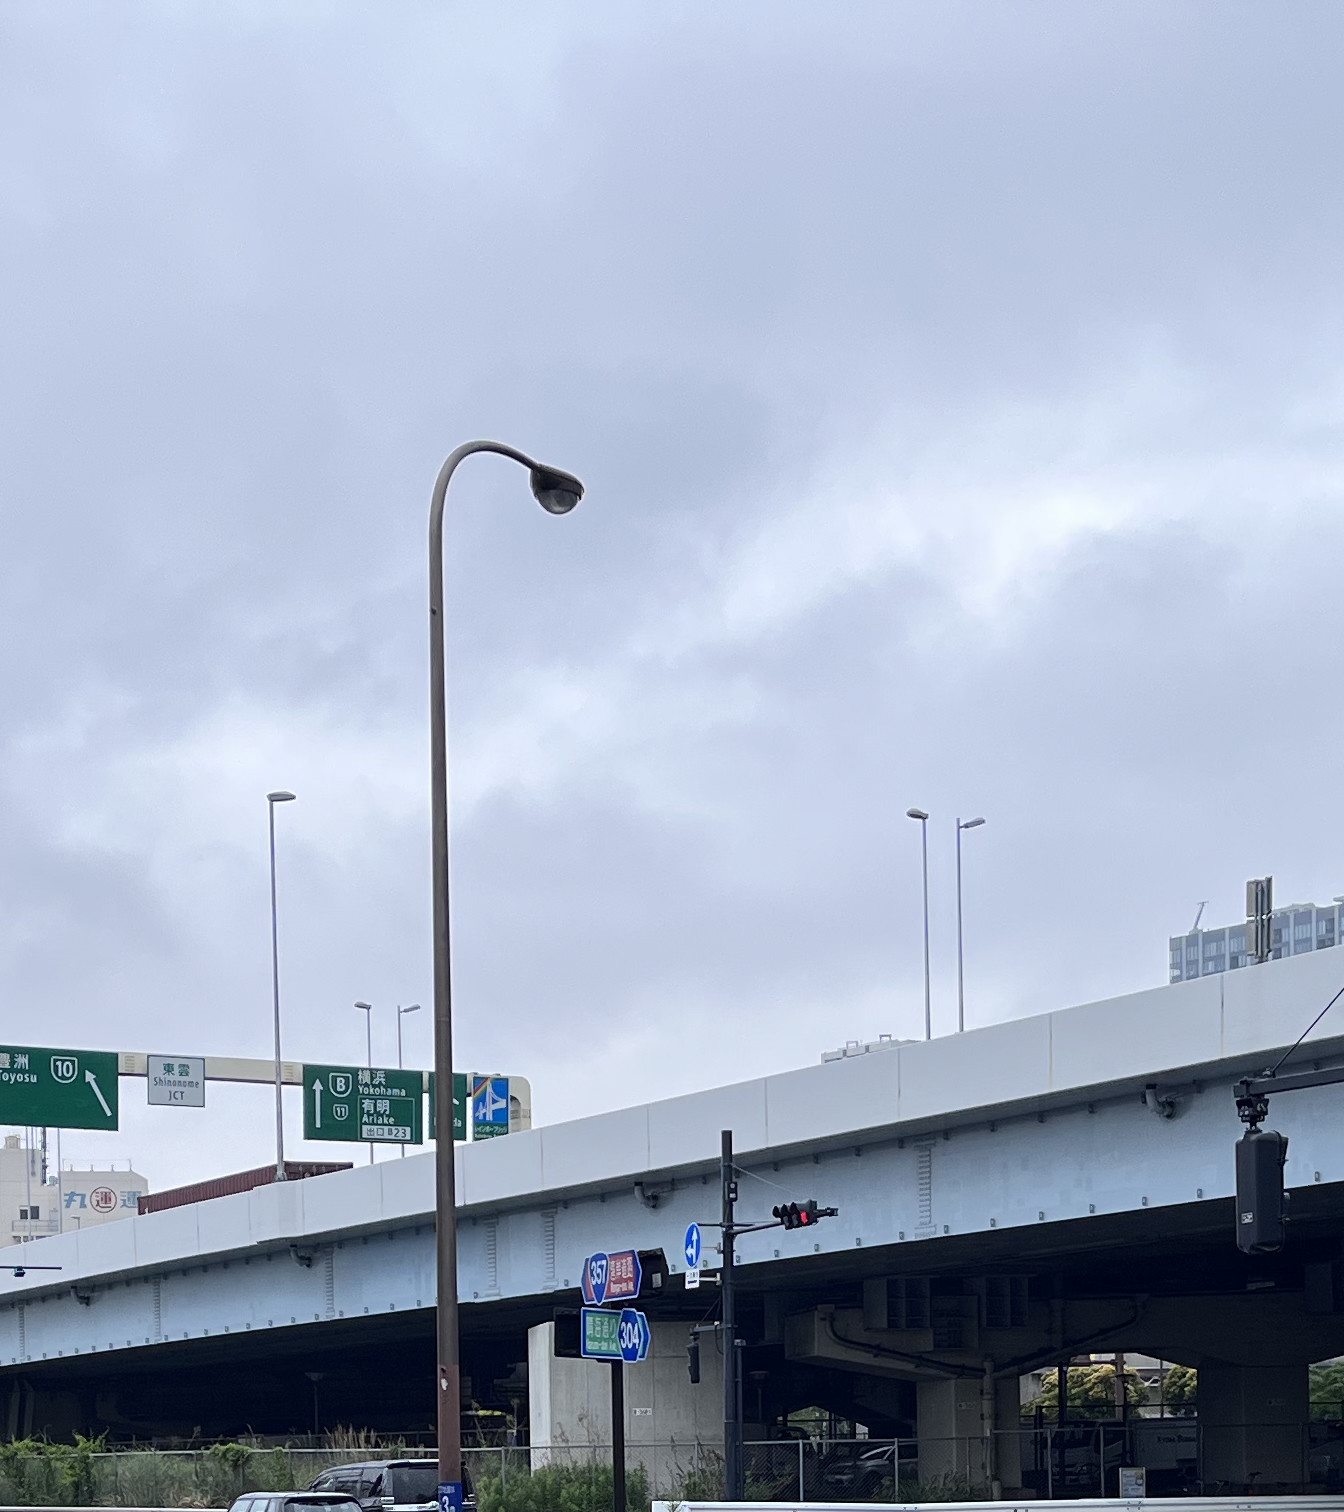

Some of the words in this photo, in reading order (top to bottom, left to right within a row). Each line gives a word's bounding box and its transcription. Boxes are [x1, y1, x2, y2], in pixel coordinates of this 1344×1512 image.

[55, 1060, 73, 1077] 10
[162, 1063, 190, 1077] 東雲
[153, 1077, 199, 1089] Shinonome
[357, 1069, 386, 1085] 横浜
[336, 1077, 345, 1092] B
[357, 1086, 406, 1097] Yokohama
[168, 1091, 185, 1101] JCT
[336, 1106, 345, 1115] 11
[361, 1100, 390, 1115] 有明
[361, 1114, 395, 1124] Ariake
[366, 1128, 384, 1137] 出口
[387, 1128, 407, 1138] B23
[590, 1260, 607, 1285] 357
[620, 1322, 639, 1349] 304
